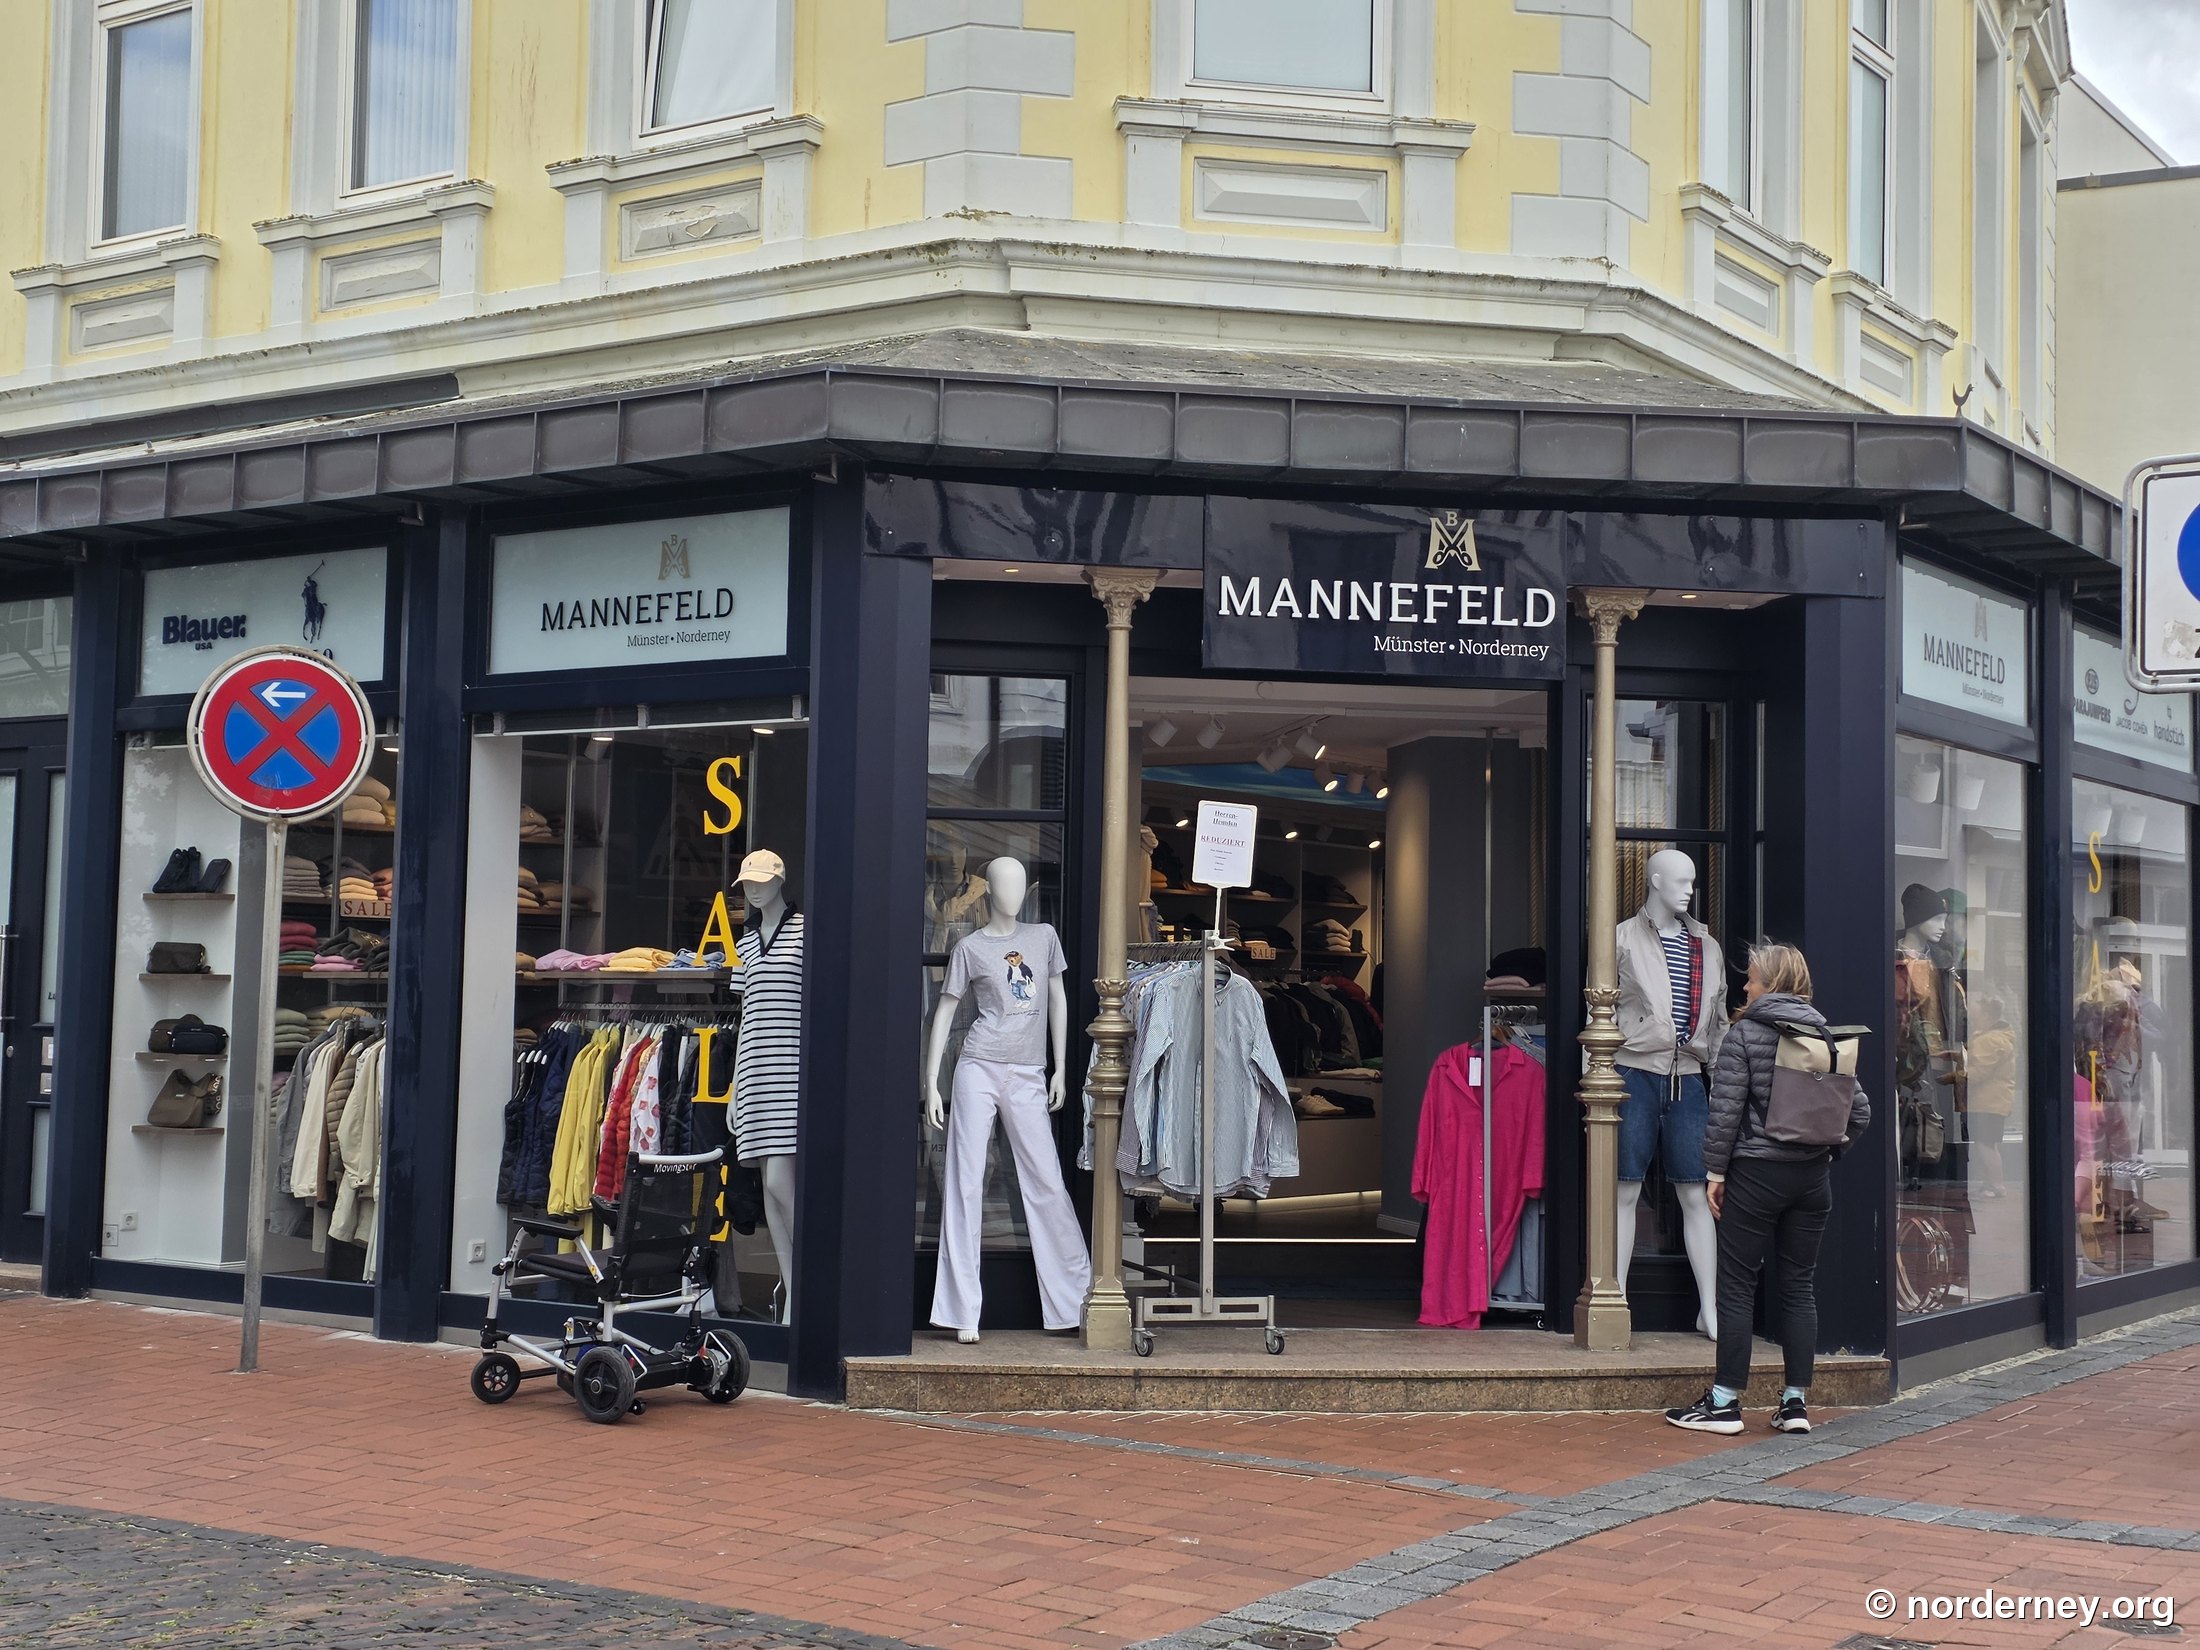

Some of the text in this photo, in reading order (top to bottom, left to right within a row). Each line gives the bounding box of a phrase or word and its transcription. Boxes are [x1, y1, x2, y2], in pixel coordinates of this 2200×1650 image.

[541, 588, 734, 631] MANNEFELD
[1218, 575, 1556, 627] MANNEFELD
[195, 641, 213, 650] USA
[627, 630, 731, 647] Münster Norderney
[1374, 635, 1549, 660] Münster Norderney
[1924, 633, 2006, 684] MANNEFELD
[1200, 835, 1246, 847] REDUZIERT
[1252, 947, 1275, 959] SALE
